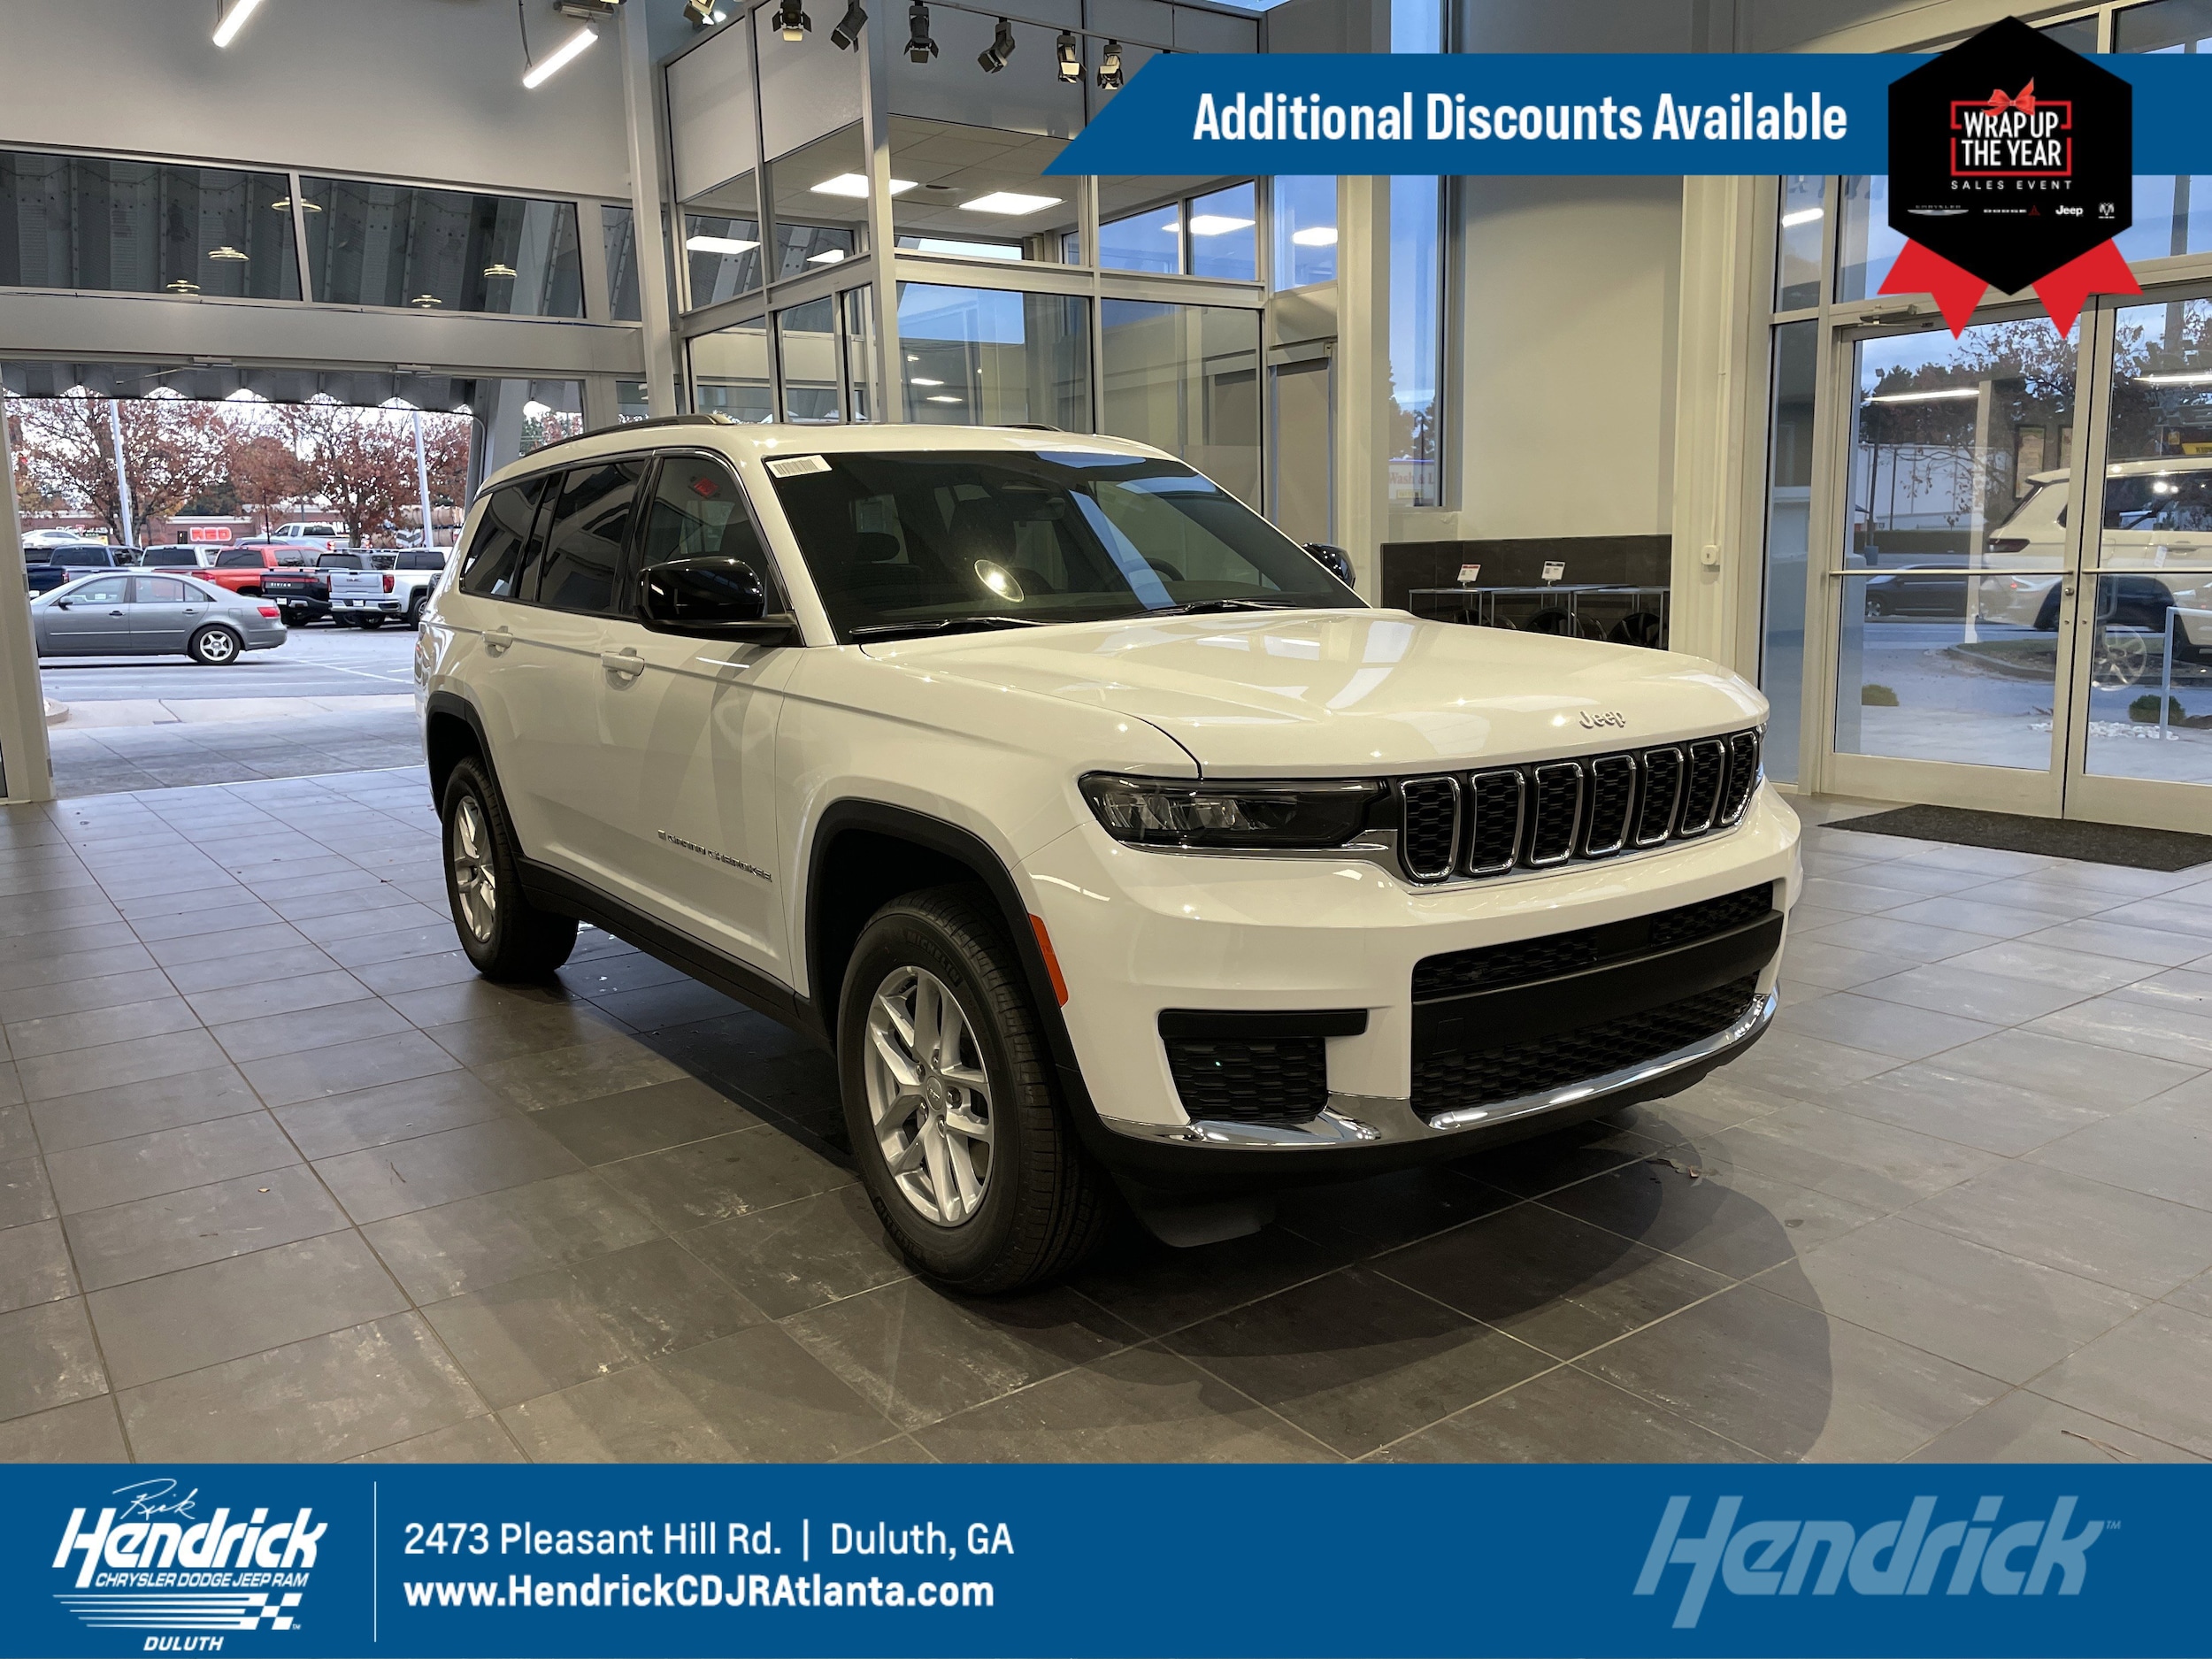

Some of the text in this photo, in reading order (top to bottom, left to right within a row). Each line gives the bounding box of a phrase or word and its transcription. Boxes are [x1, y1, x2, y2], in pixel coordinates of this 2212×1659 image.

[190, 526, 232, 541] RED
[1579, 710, 1626, 729] Jeep
[667, 833, 772, 882] GRAND CHEROKEE
[906, 930, 961, 984] MICHELIN
